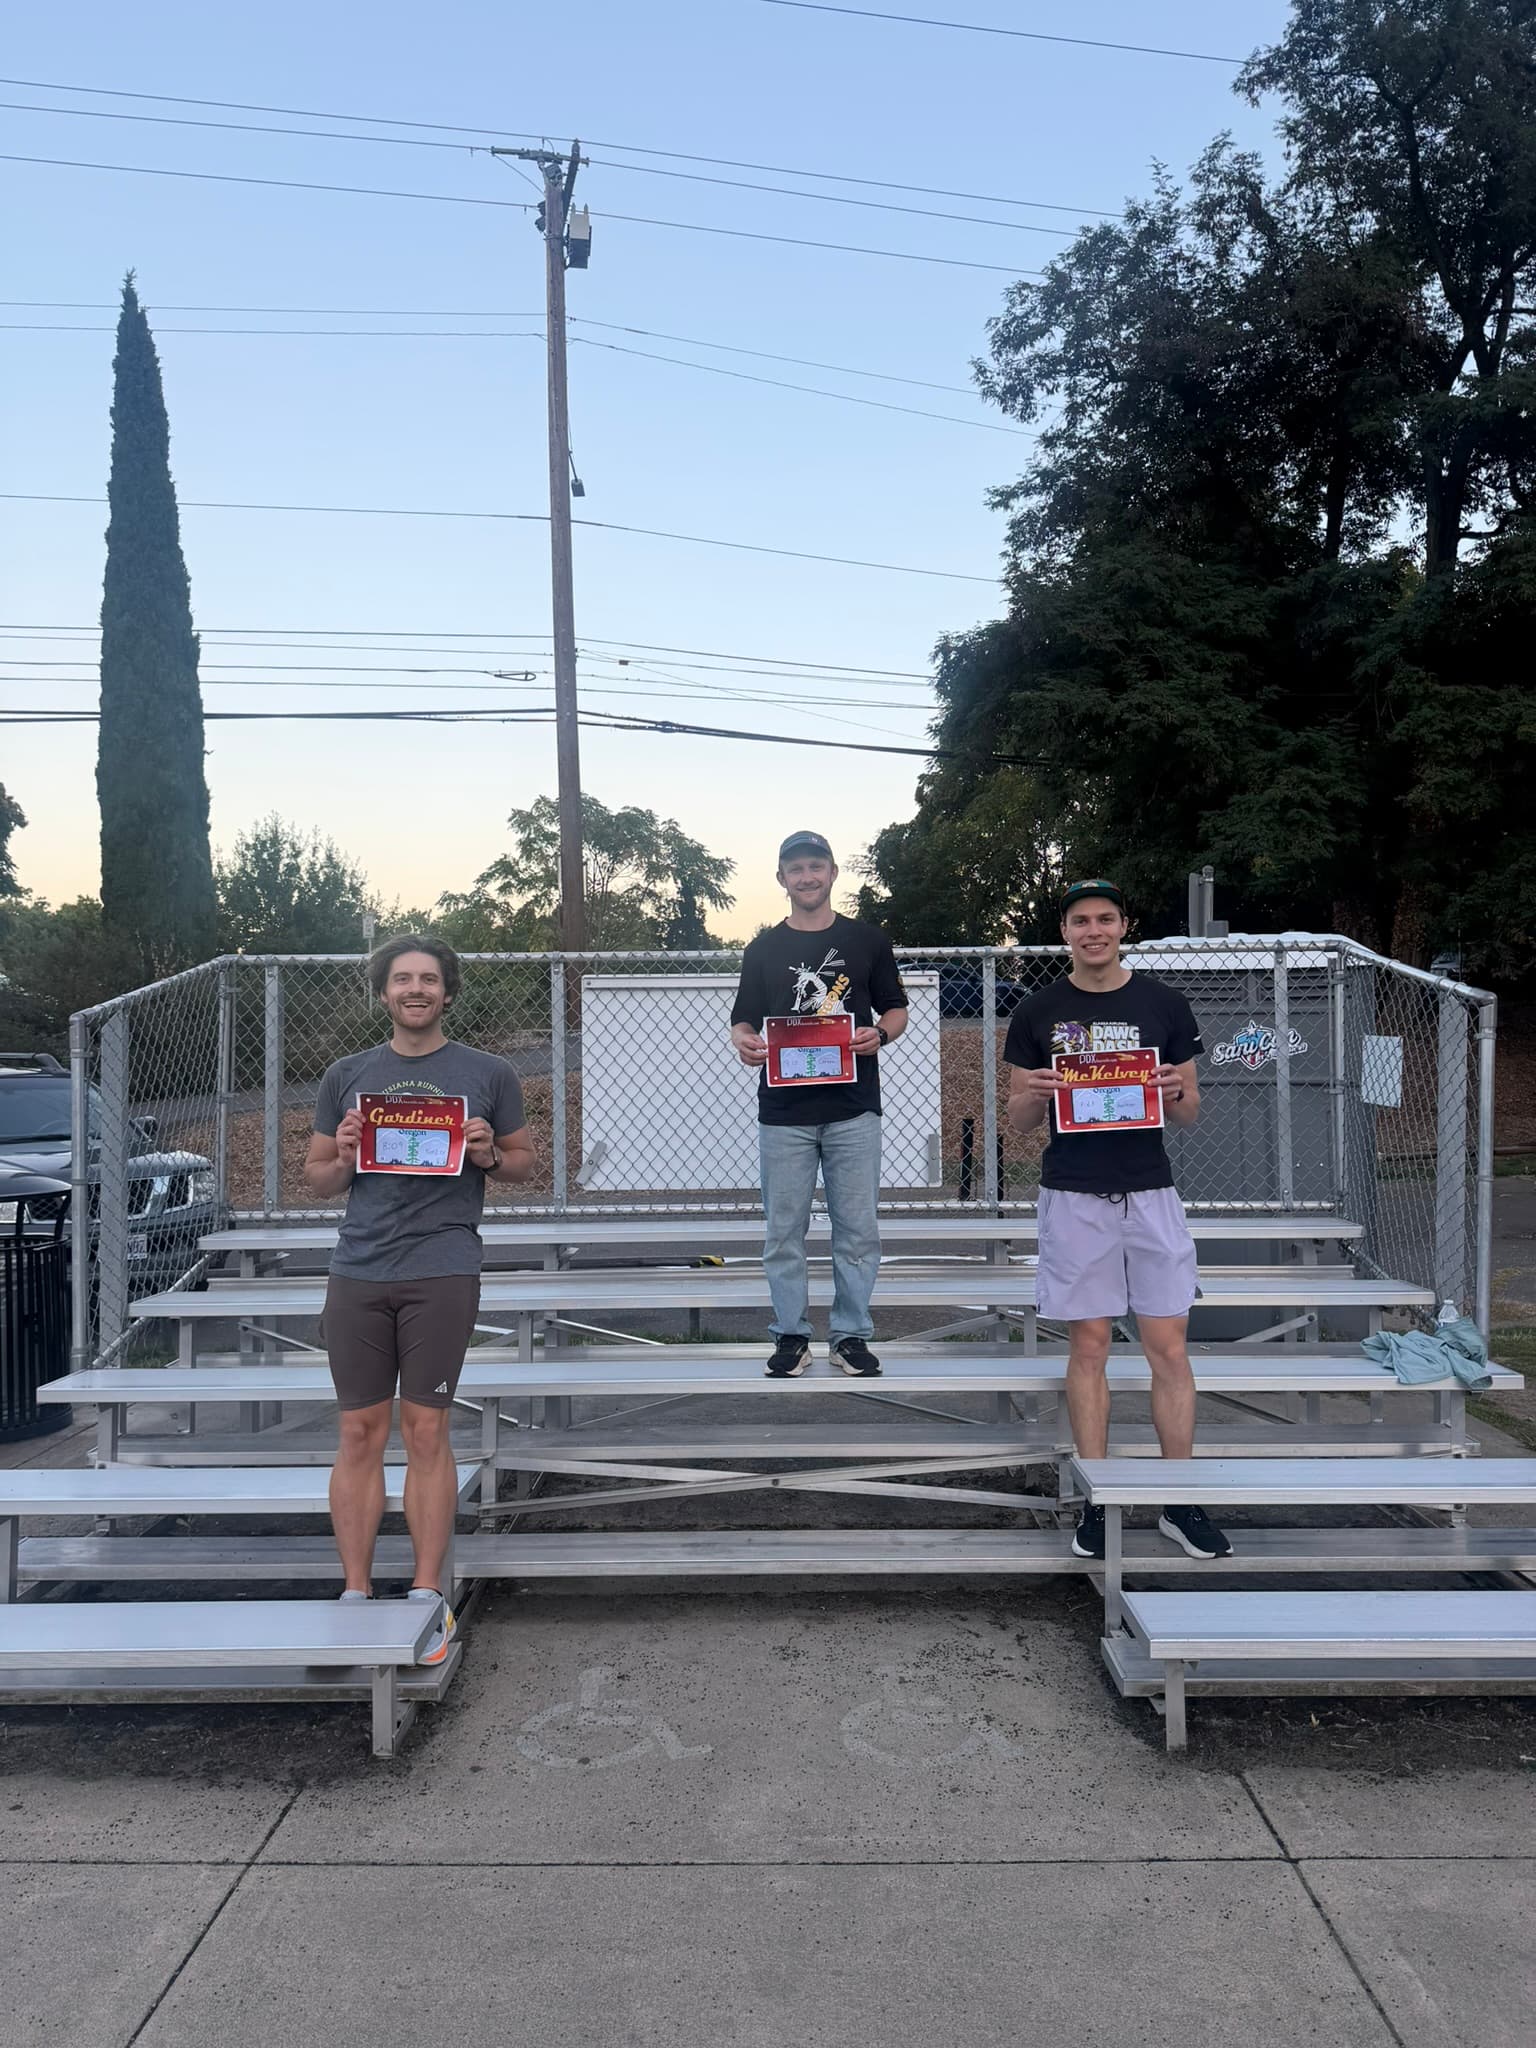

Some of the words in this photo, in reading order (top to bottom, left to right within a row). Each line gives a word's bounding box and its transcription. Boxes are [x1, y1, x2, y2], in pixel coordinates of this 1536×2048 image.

[1093, 1026, 1139, 1040] DAWG
[1093, 1040, 1140, 1051] DASH
[1079, 1054, 1096, 1064] PDX
[1061, 1065, 1151, 1083] McKelvey
[369, 1107, 455, 1126] Gardiner
